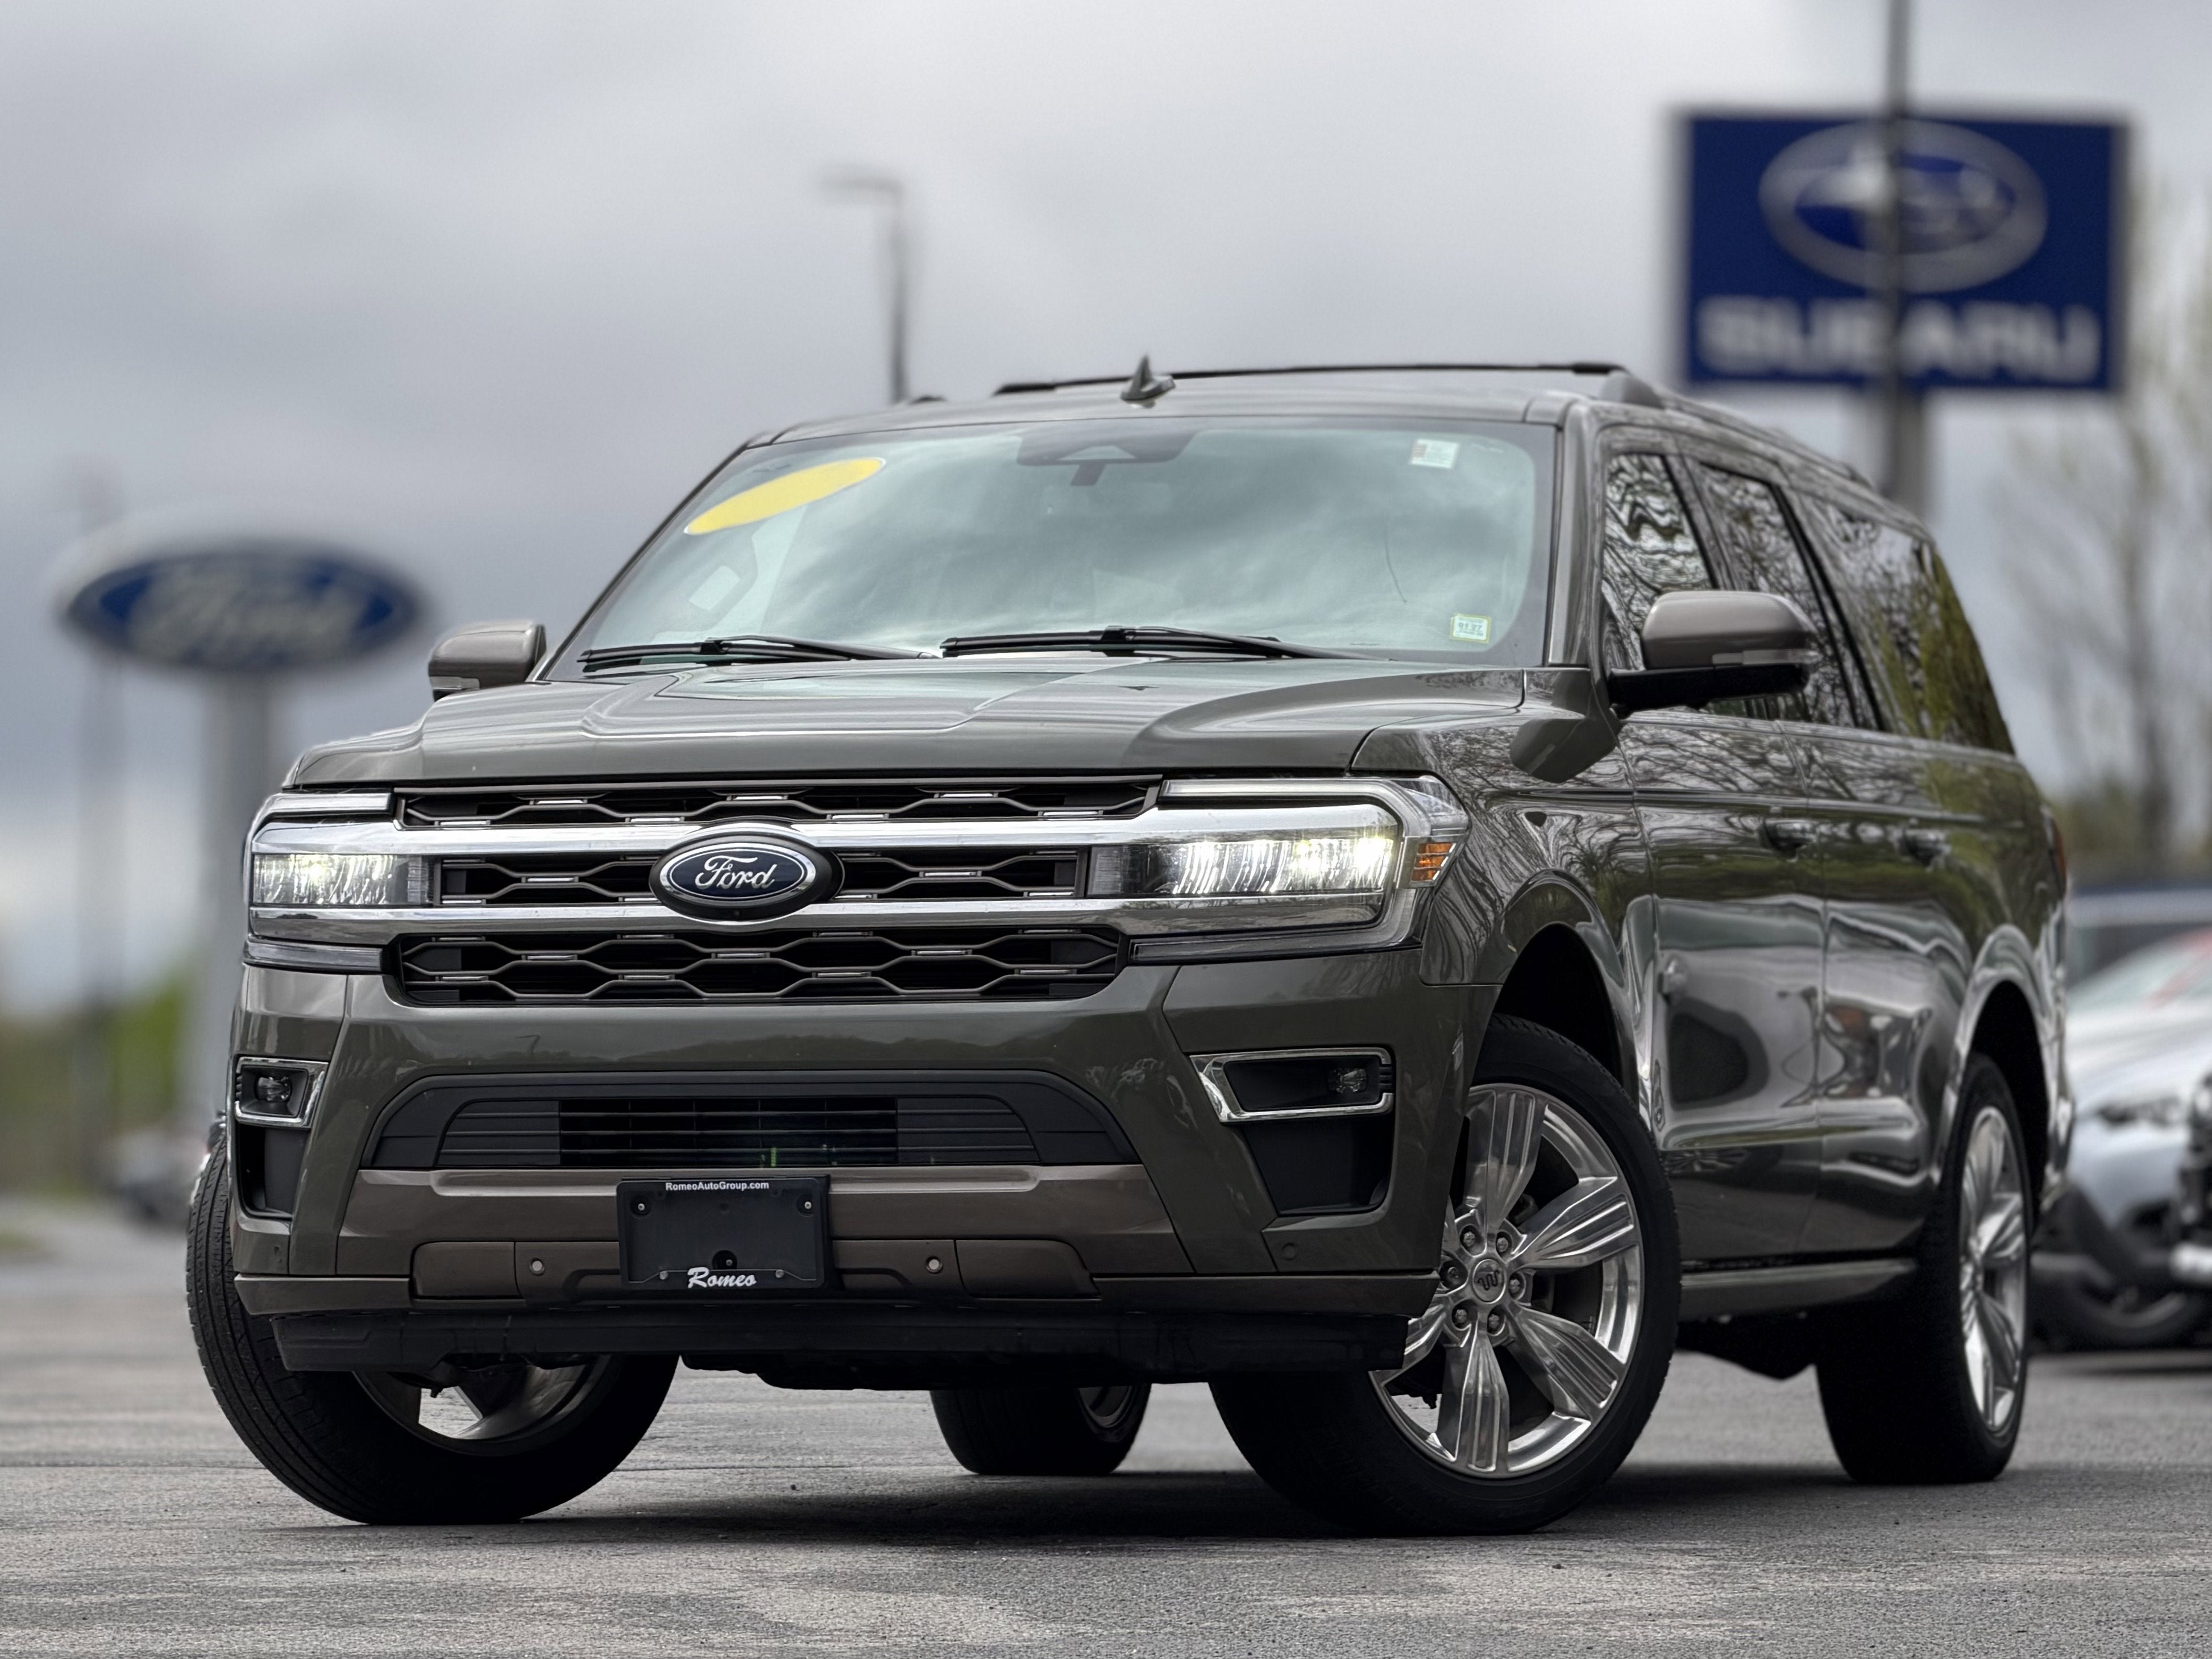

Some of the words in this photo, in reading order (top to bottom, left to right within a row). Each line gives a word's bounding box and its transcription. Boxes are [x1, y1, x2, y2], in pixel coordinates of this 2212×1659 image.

[695, 855, 778, 890] Ford
[665, 1181, 770, 1192] RomeoAutoGroup.com
[687, 1266, 757, 1289] Romeo
